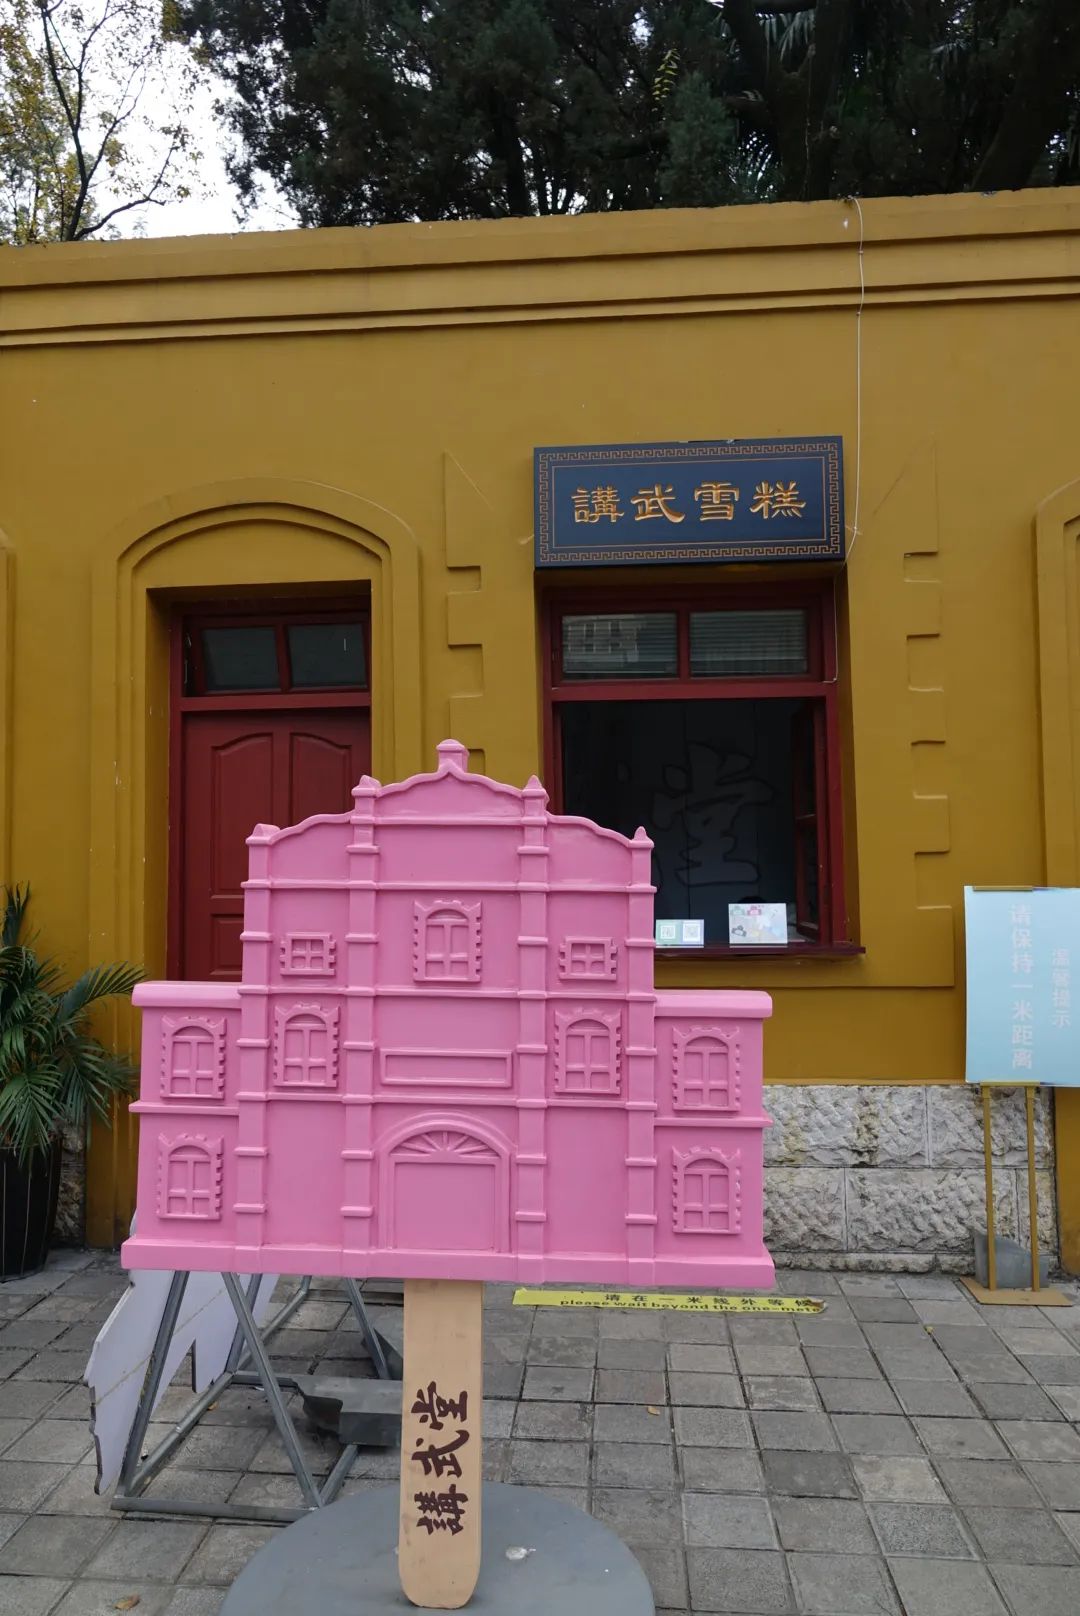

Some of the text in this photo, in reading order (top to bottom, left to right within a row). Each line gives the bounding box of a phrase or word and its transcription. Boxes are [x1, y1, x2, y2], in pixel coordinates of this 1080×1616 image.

[570, 479, 807, 524] 講武雪糕
[1010, 904, 1034, 1070] 请保持一米距离
[651, 1302, 708, 1310] beyond
[410, 1380, 471, 1537] 講武堂
